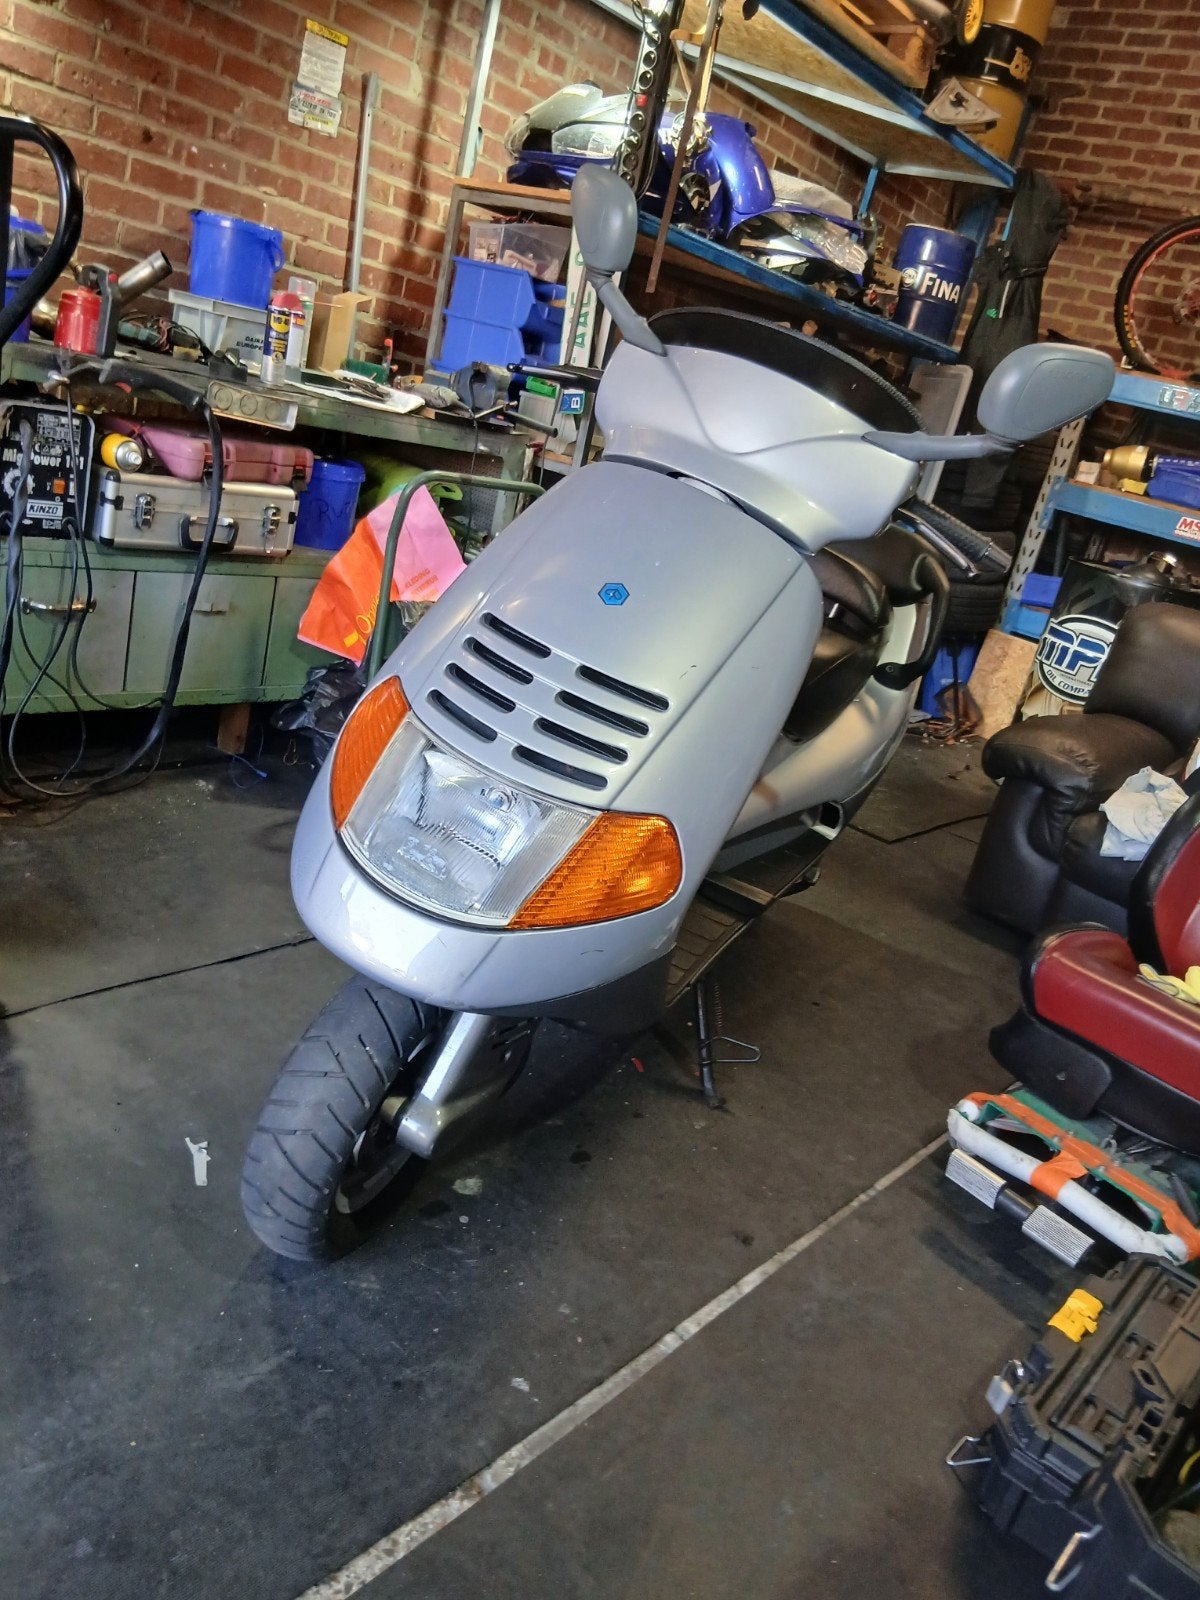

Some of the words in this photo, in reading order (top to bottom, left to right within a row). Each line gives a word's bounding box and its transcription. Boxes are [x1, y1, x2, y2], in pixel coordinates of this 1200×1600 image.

[919, 272, 960, 303] FINA
[570, 396, 581, 408] B
[27, 504, 59, 515] KINZO
[1046, 669, 1057, 682] OIL
